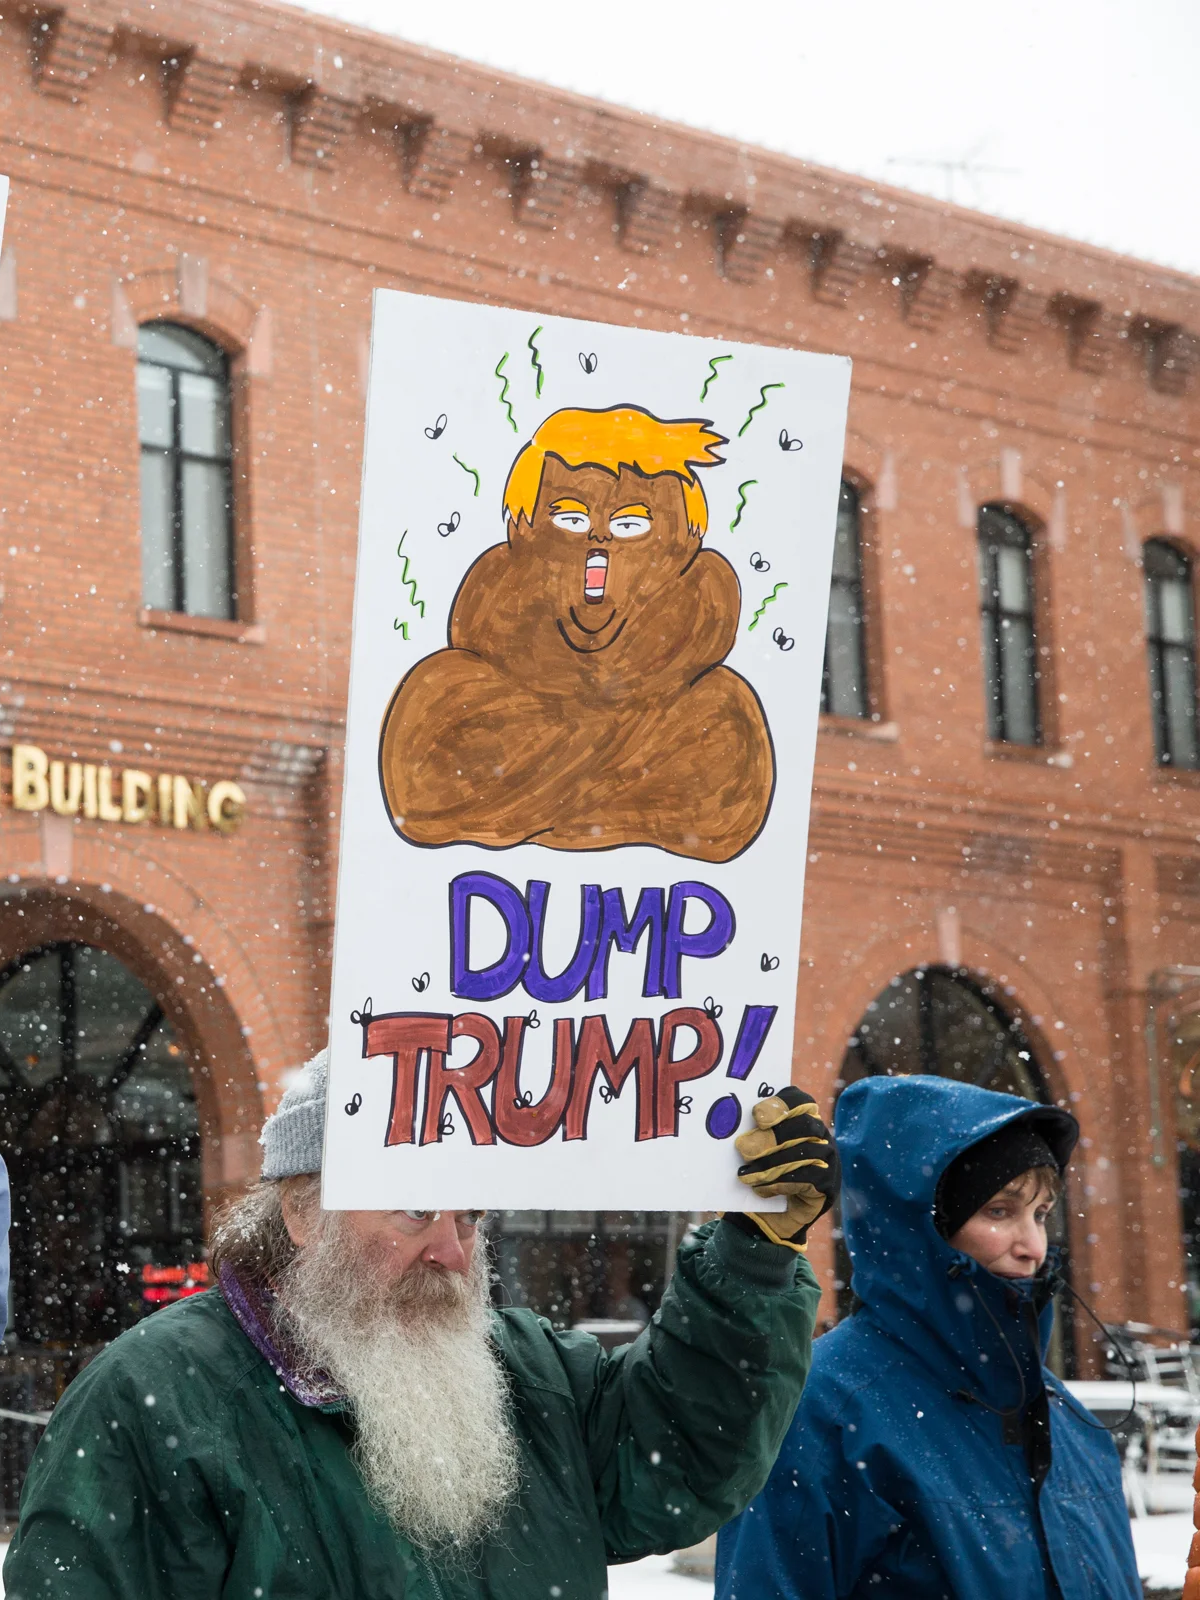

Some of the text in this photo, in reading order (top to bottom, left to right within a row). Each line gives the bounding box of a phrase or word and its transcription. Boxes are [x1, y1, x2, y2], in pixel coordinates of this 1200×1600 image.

[12, 744, 246, 832] BUILDING
[449, 870, 736, 1003] DUMP
[362, 1006, 777, 1147] TRUMP!
